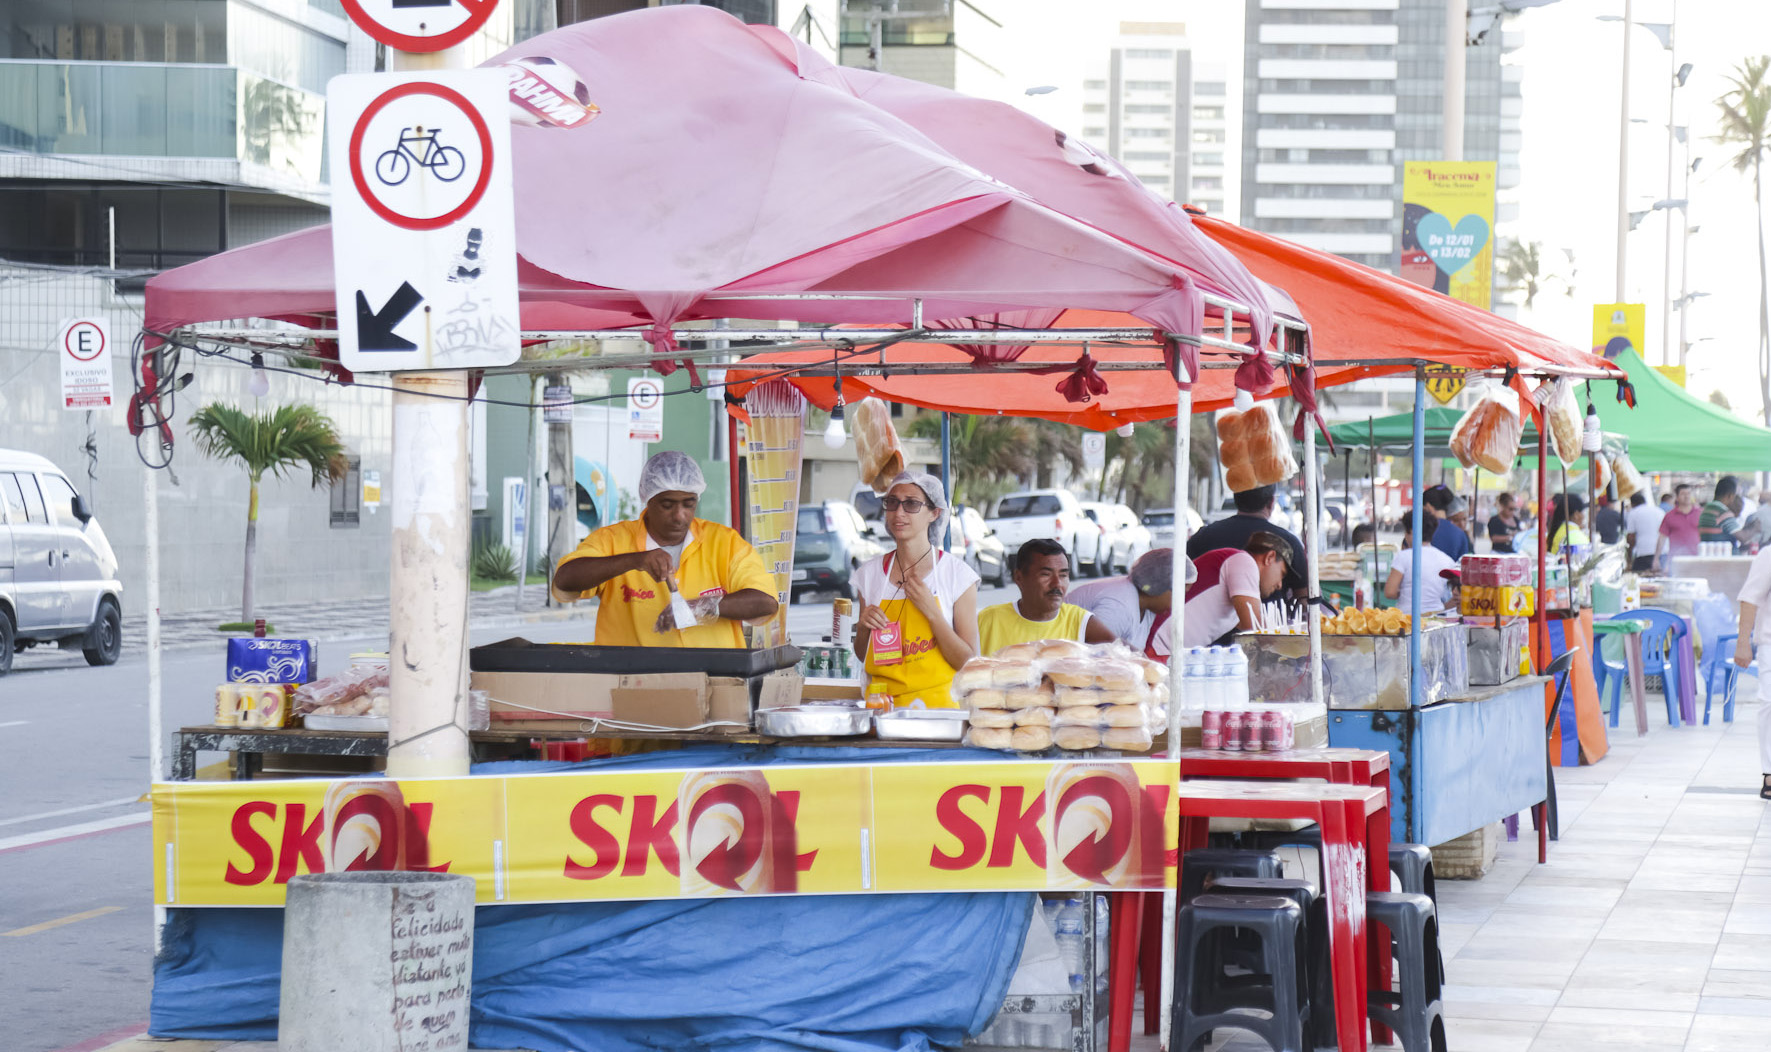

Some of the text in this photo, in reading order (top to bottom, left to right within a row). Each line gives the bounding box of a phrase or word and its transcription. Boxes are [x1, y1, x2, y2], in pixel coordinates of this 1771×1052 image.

[509, 66, 586, 126] RAHMA
[1429, 234, 1474, 245] De 12/01
[1441, 247, 1471, 258] 13/02
[79, 331, 92, 351] E
[65, 368, 107, 377] EXCLUSIVO
[1470, 598, 1496, 611] SKOL
[224, 794, 452, 886] SKOL
[563, 783, 819, 892] SKOL
[929, 776, 1179, 886] SKOL
[390, 992, 431, 1014] para
